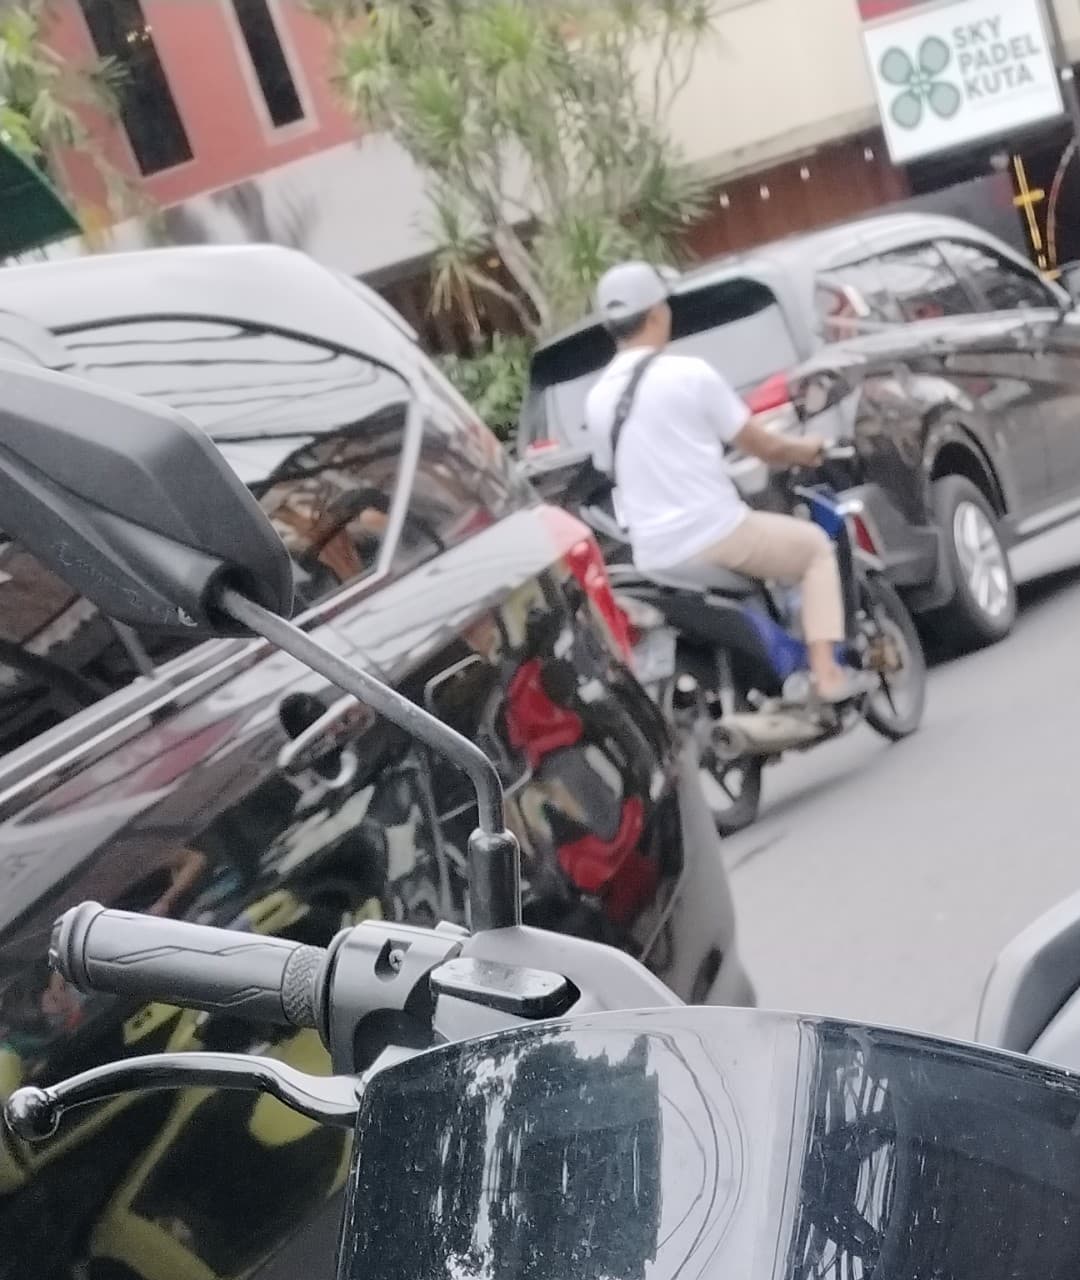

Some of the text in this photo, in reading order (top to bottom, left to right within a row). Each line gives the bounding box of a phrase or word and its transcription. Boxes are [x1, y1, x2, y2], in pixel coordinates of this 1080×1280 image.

[952, 15, 1002, 49] SKY
[958, 33, 1041, 74] PADEL
[963, 63, 1034, 100] KUTA
